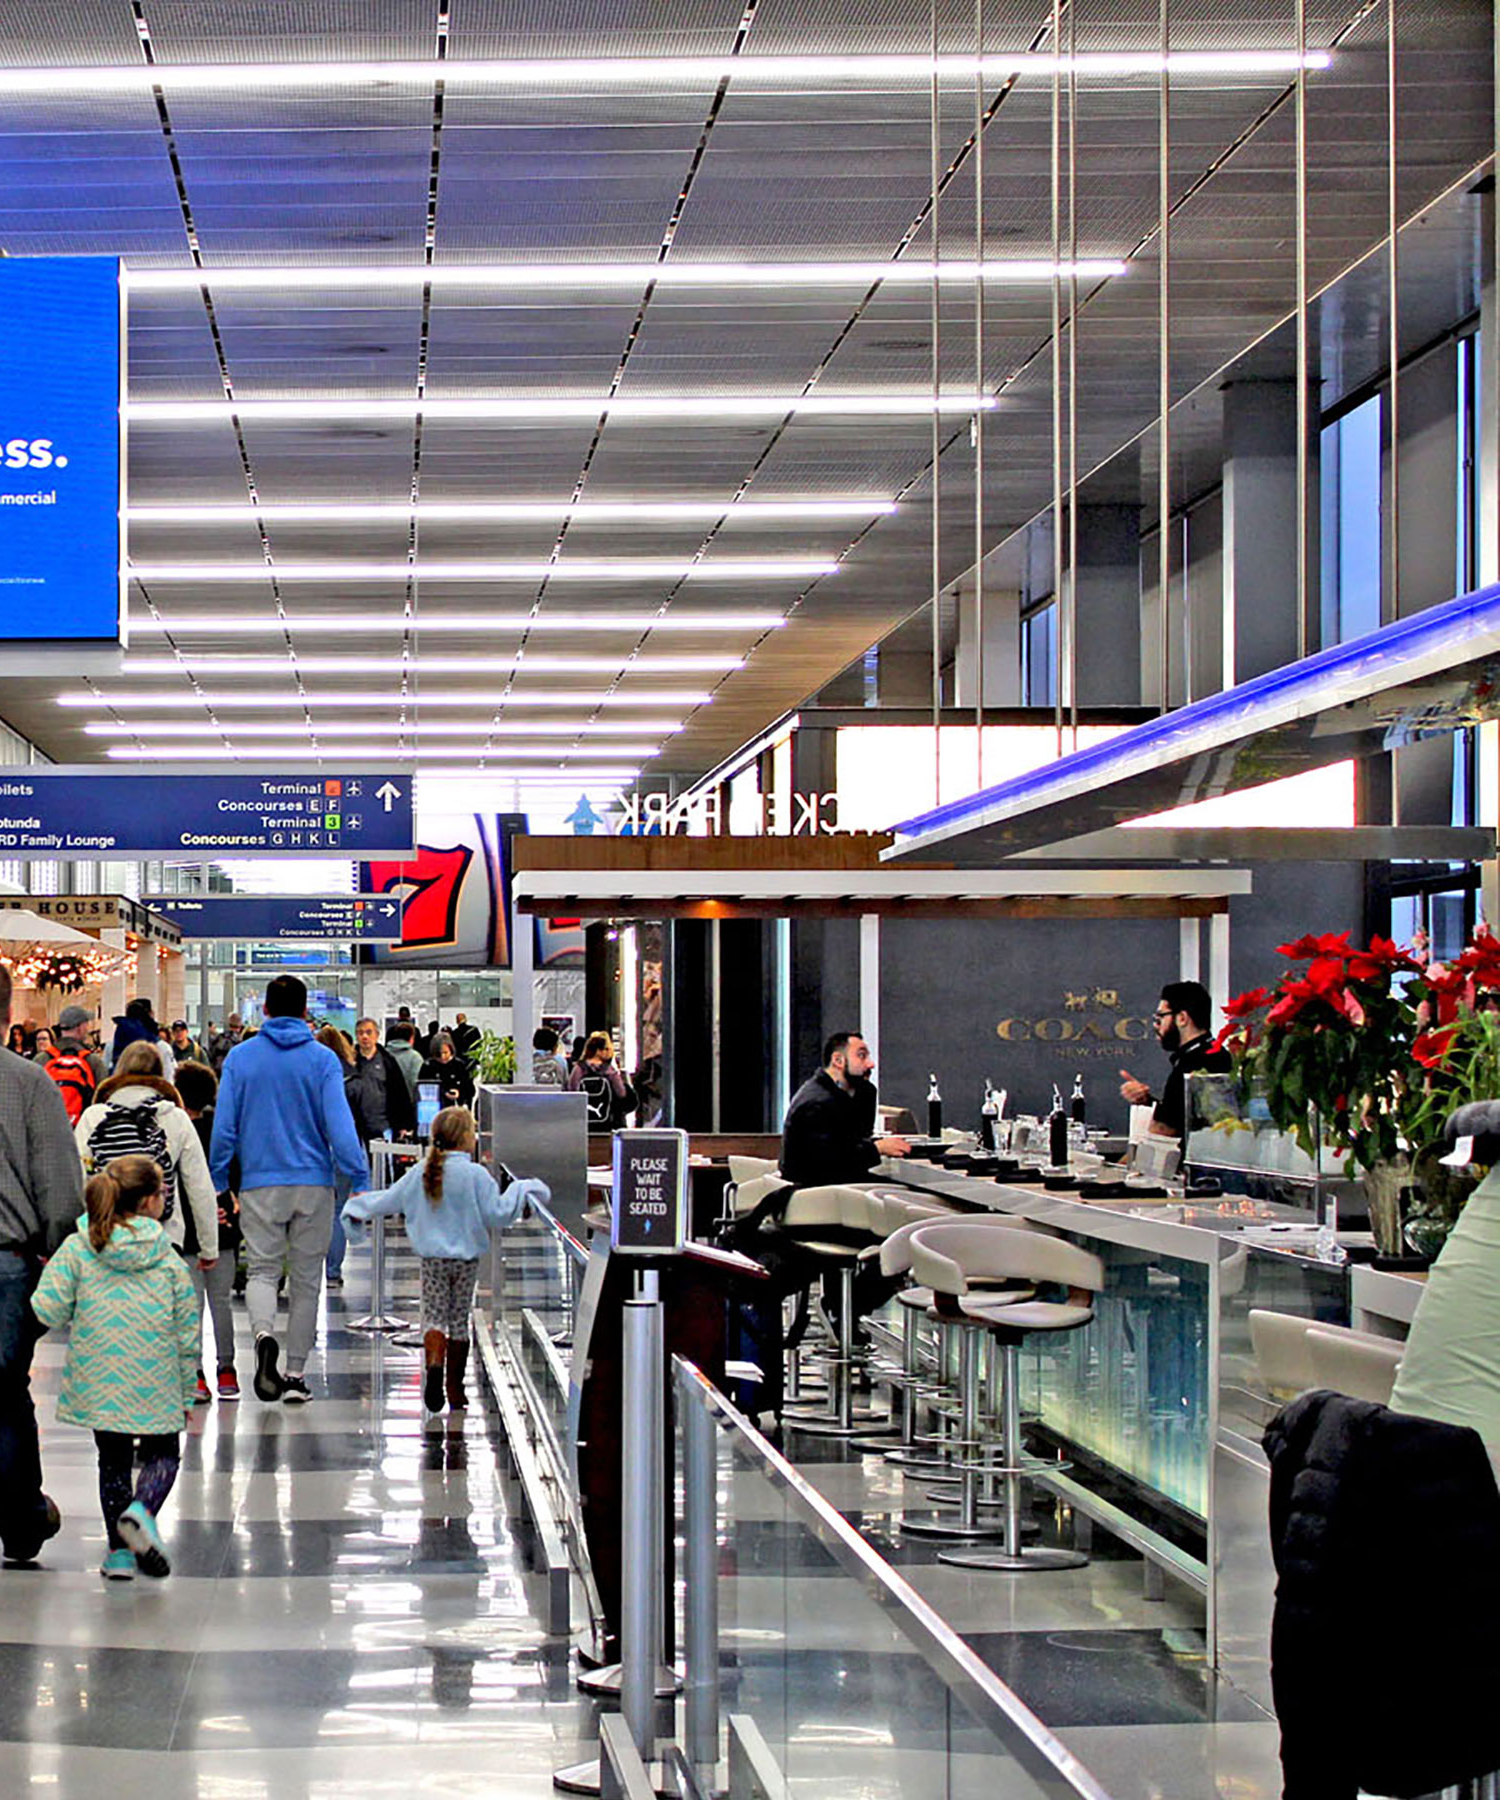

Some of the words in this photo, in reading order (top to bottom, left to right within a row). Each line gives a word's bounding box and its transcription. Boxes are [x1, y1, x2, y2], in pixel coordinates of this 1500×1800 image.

[261, 782, 322, 795] Terminal
[217, 799, 303, 811] Concourses
[309, 800, 319, 811] E
[328, 800, 338, 811] F
[261, 816, 322, 828] Terminal
[20, 834, 63, 849] Family
[66, 834, 116, 850] Lounge
[180, 832, 266, 846] Concourses
[272, 833, 283, 845] G
[291, 833, 301, 844] H
[309, 833, 319, 844] K
[328, 832, 337, 844] L
[39, 902, 115, 914] HOUSE
[996, 1018, 1150, 1041] COAC
[631, 1158, 668, 1171] PLEASE
[636, 1173, 662, 1185] WAIT
[635, 1187, 648, 1200] TO
[649, 1187, 663, 1200] BE
[629, 1202, 668, 1215] SEATED
